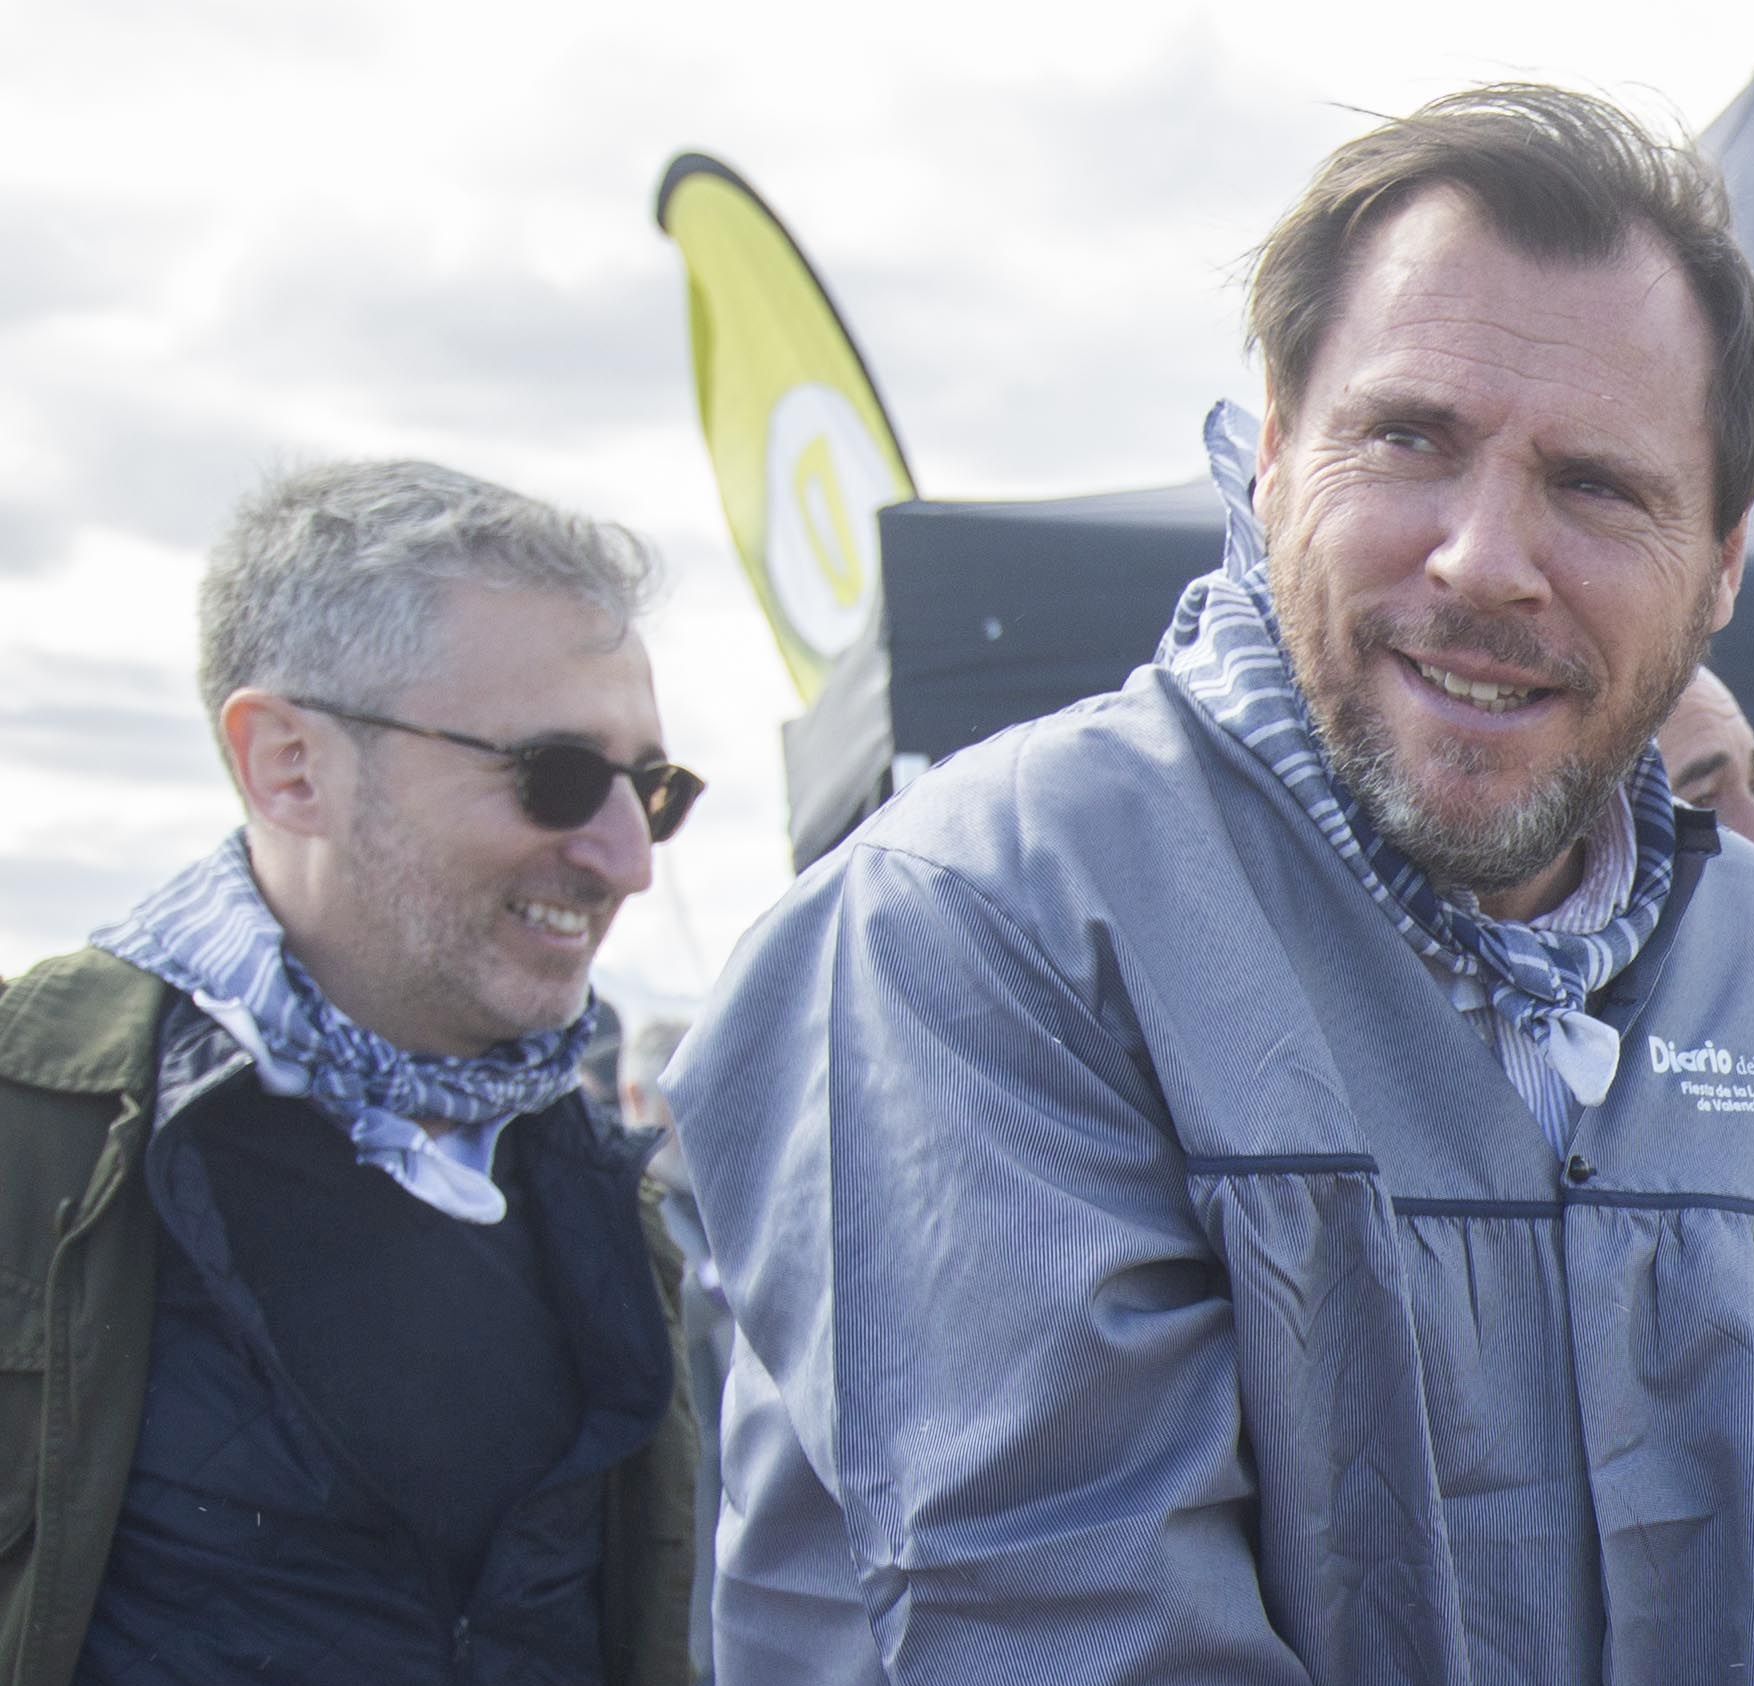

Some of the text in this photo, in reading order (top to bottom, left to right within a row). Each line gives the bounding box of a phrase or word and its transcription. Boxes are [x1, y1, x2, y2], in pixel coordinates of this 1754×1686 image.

[1649, 1035, 1732, 1075] Diario
[1681, 1081, 1714, 1097] Fiesta
[1716, 1084, 1732, 1098] de
[1697, 1097, 1712, 1111] de
